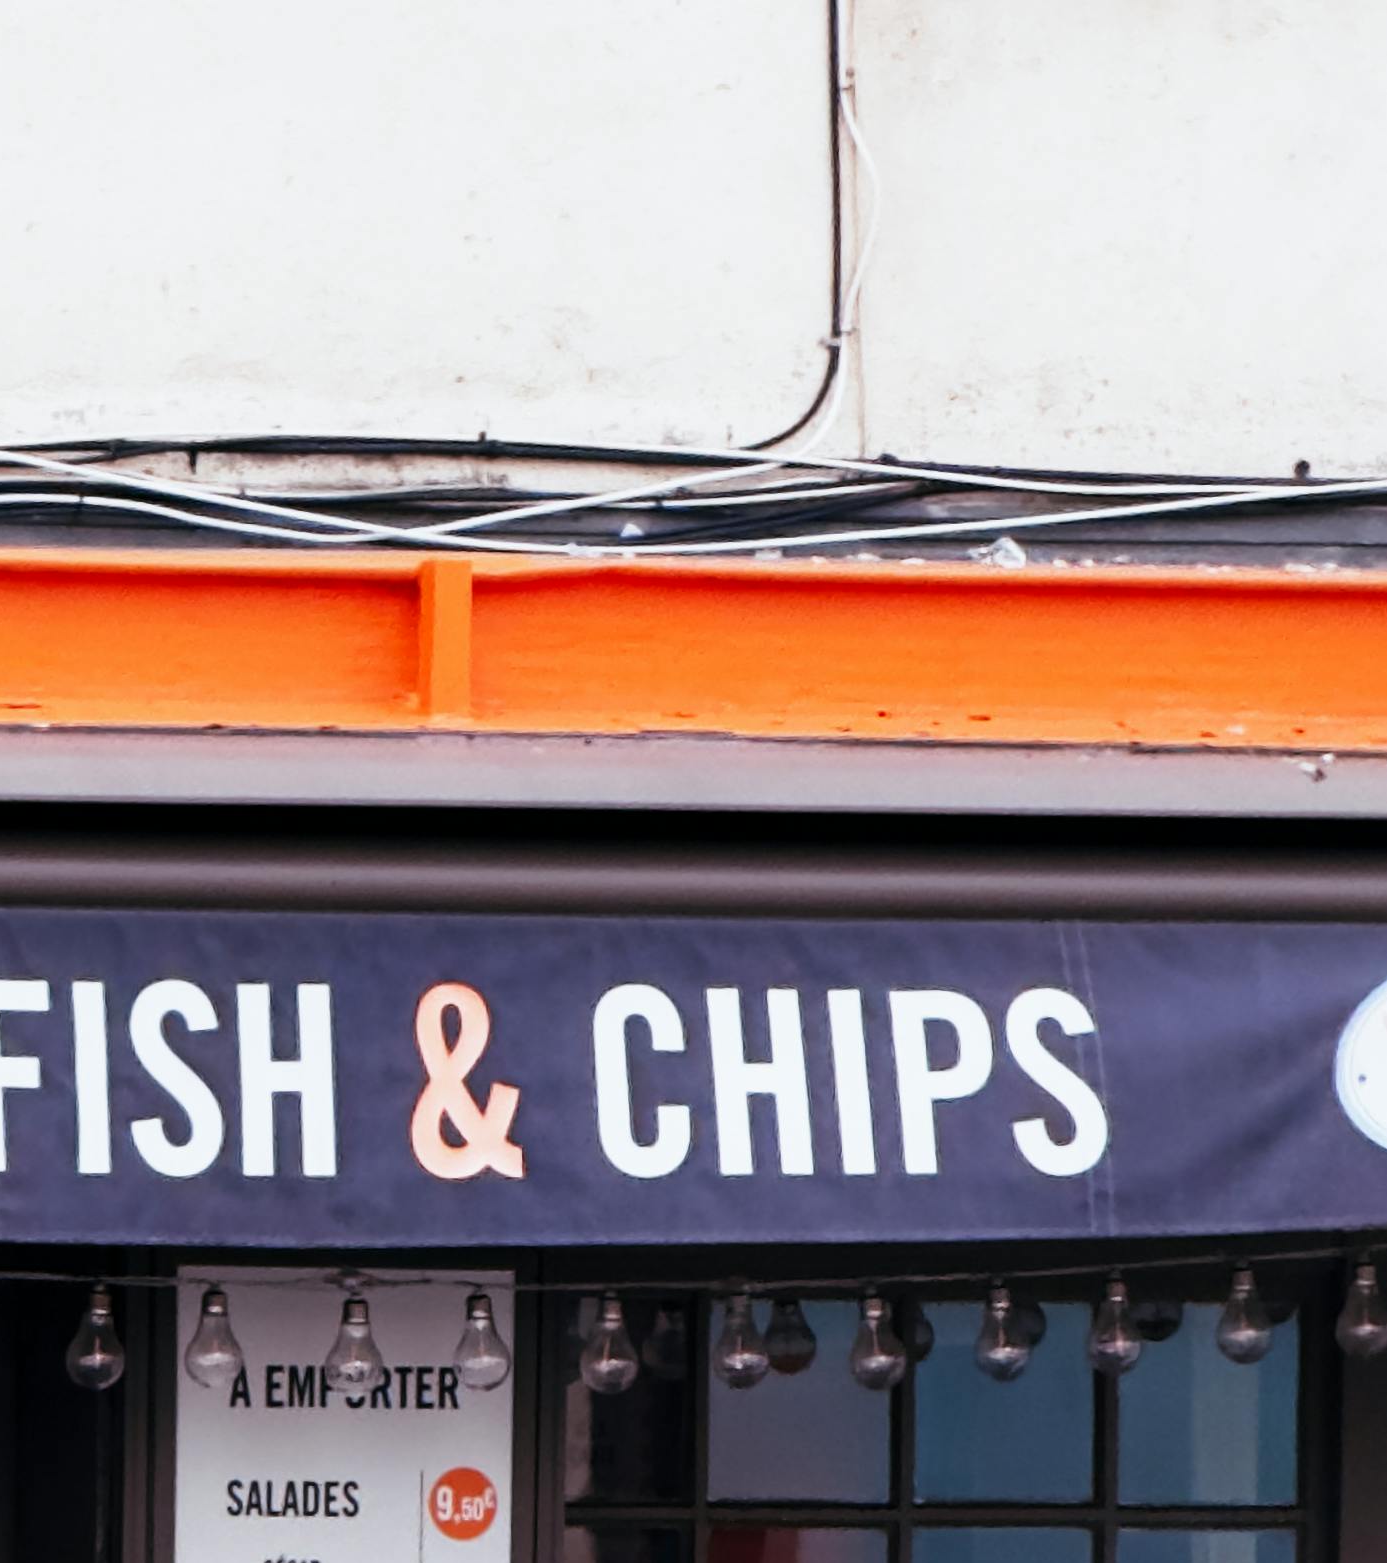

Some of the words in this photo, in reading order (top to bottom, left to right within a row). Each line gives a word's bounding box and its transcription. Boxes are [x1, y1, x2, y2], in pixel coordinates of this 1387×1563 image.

[410, 981, 526, 1179] &
[591, 986, 1111, 1178] CHIPS
[226, 1480, 360, 1518] SALADES
